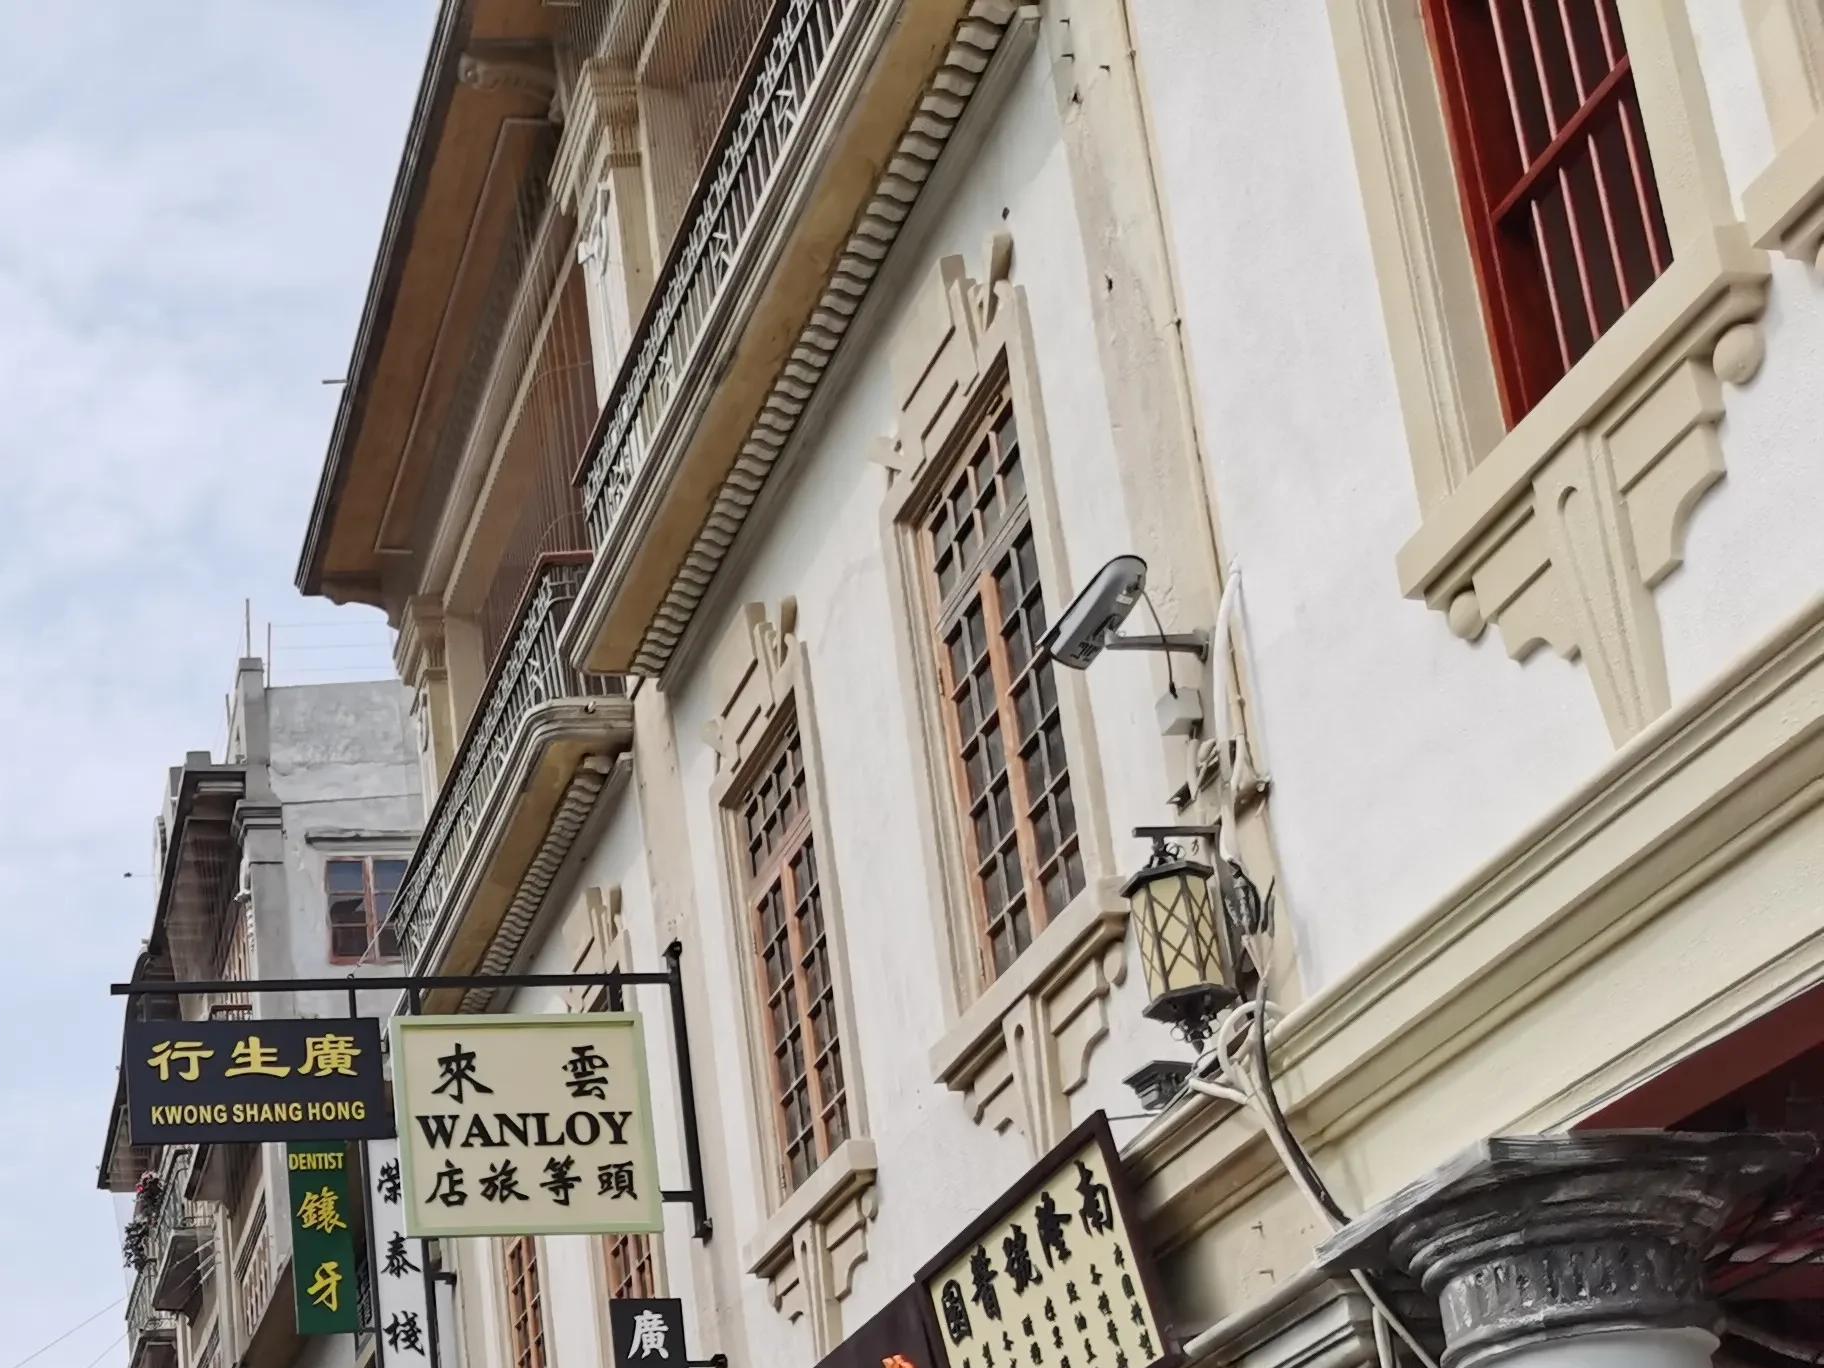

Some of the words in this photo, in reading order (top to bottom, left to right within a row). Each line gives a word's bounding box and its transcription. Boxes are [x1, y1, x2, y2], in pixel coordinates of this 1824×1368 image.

[151, 1104, 228, 1126] KWONG
[232, 1102, 303, 1124] SHANG
[308, 1100, 366, 1122] HONG
[415, 1110, 633, 1150] WANLOY
[288, 1151, 344, 1172] DENTIST
[296, 1189, 347, 1312] 鑲牙
